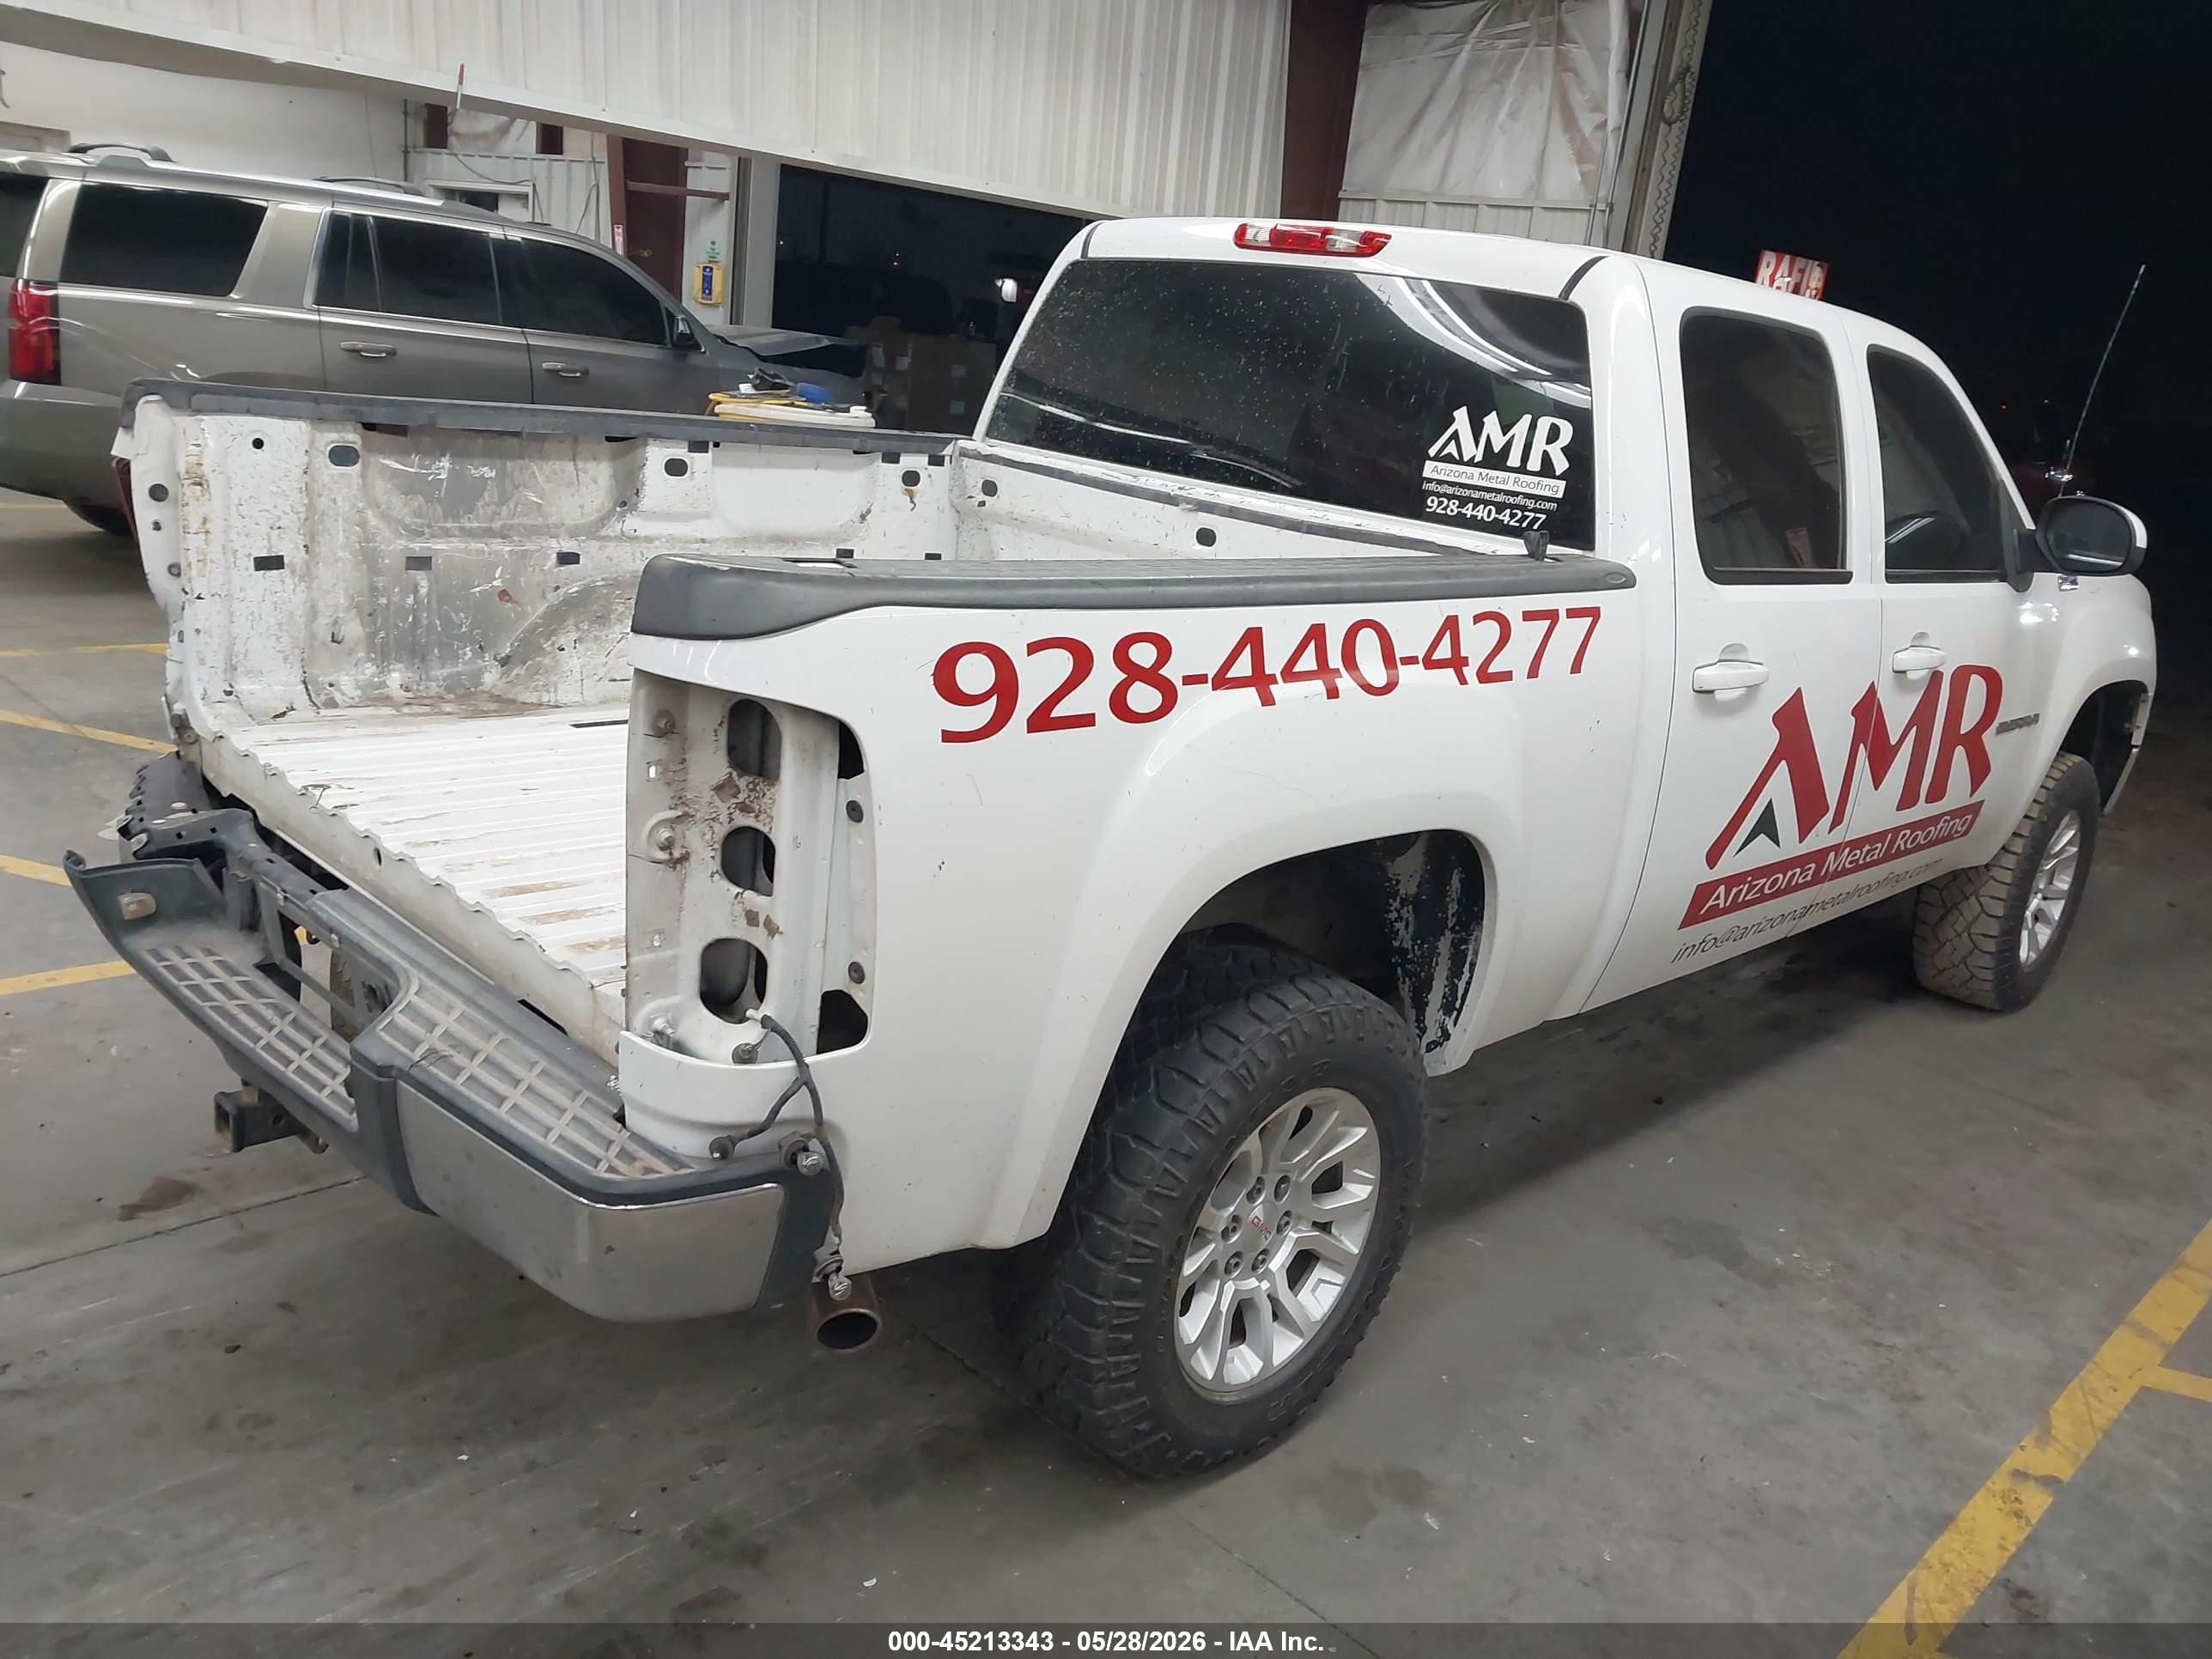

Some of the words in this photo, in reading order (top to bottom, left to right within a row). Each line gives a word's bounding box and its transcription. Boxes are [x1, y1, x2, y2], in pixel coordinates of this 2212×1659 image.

[1428, 405, 1573, 476] AMR
[1422, 481, 1558, 511] info@arizonametalroofing.com
[1431, 465, 1474, 480] Arizona
[1477, 473, 1510, 486] Metal
[1512, 477, 1560, 495] Roofing
[1425, 496, 1547, 530] 928-440-4277
[933, 607, 1601, 743] 928-440-4277
[1705, 665, 2003, 870] AMR
[1699, 862, 1815, 915] Arizona
[1820, 833, 1893, 877] Metal
[1891, 813, 1973, 854] Roofing
[1251, 1216, 1272, 1241] GMC
